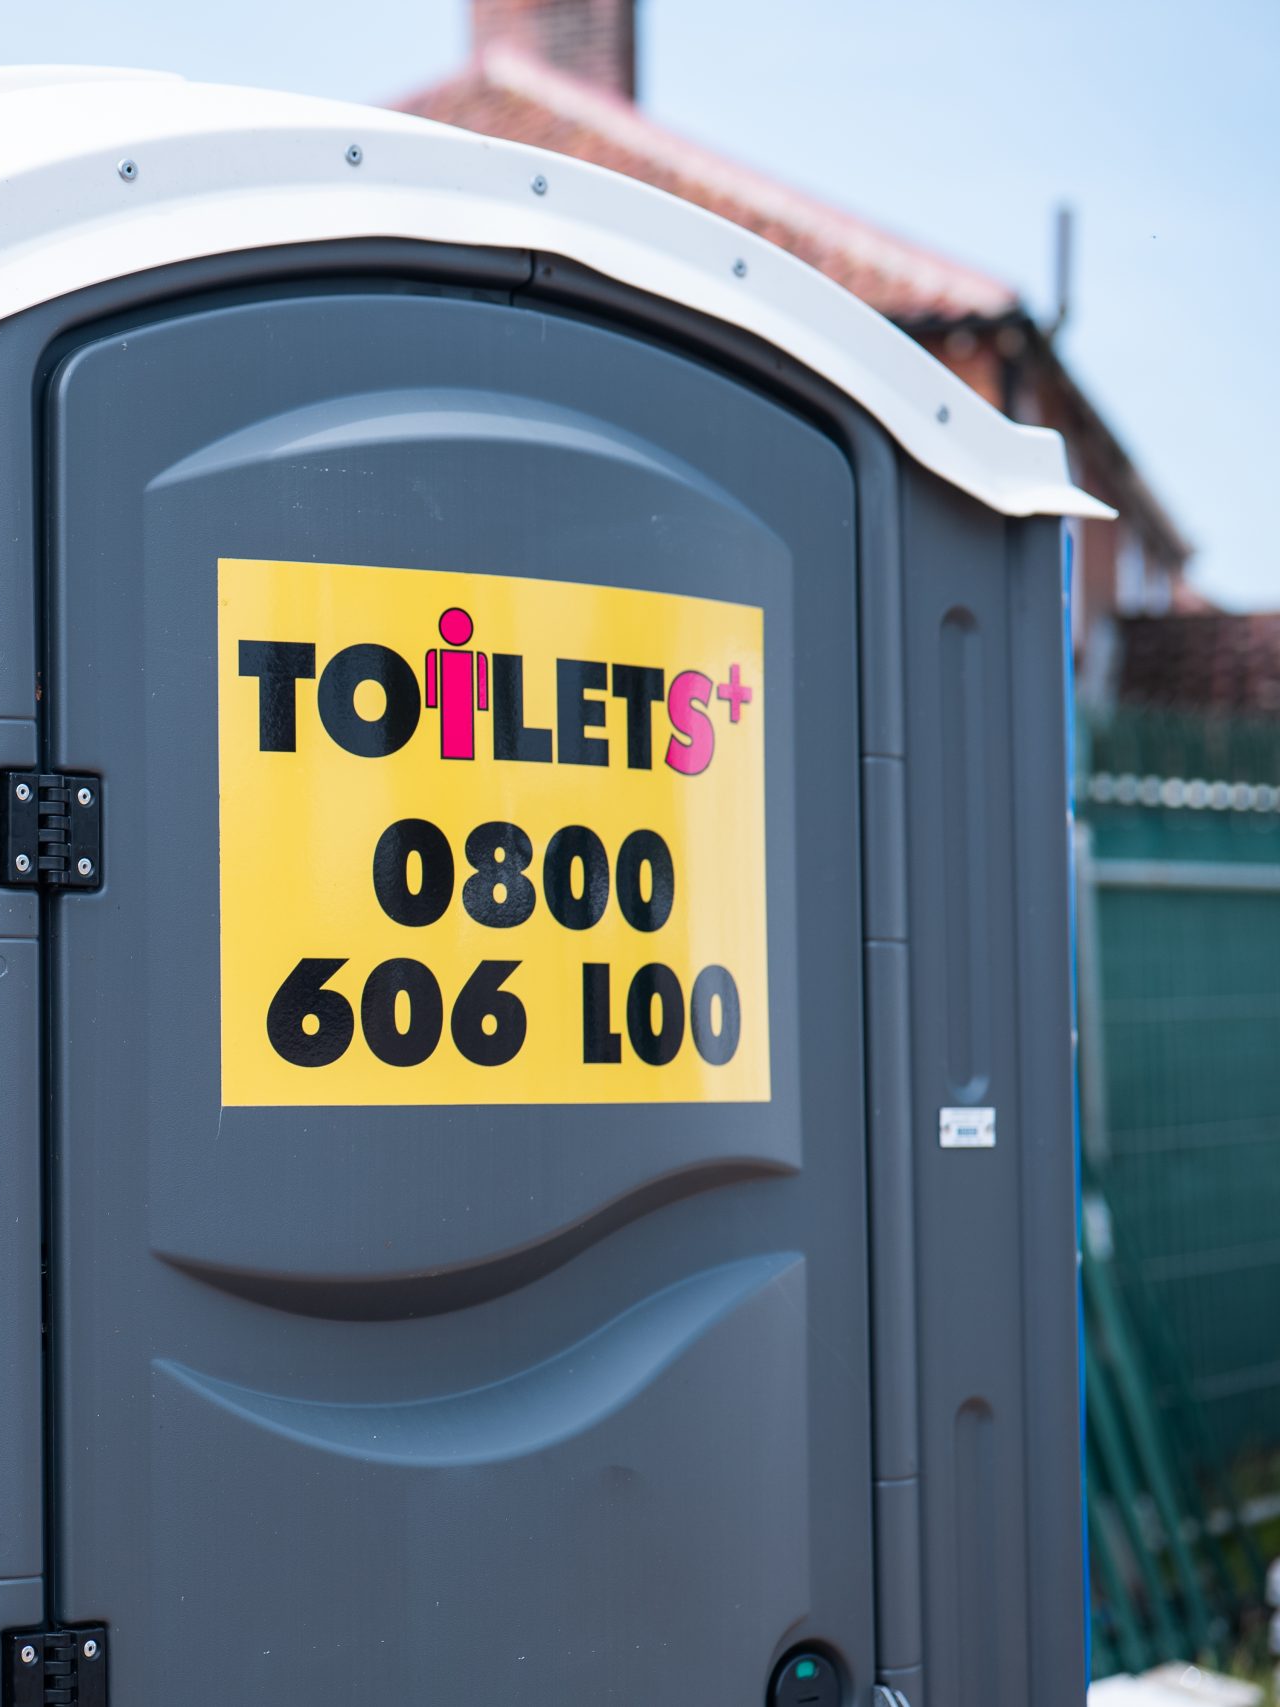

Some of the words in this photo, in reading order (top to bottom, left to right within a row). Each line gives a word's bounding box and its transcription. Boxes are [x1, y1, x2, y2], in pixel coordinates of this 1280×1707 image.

[372, 818, 675, 933] 0800
[266, 957, 527, 1068] 606
[582, 961, 741, 1067] LOO
